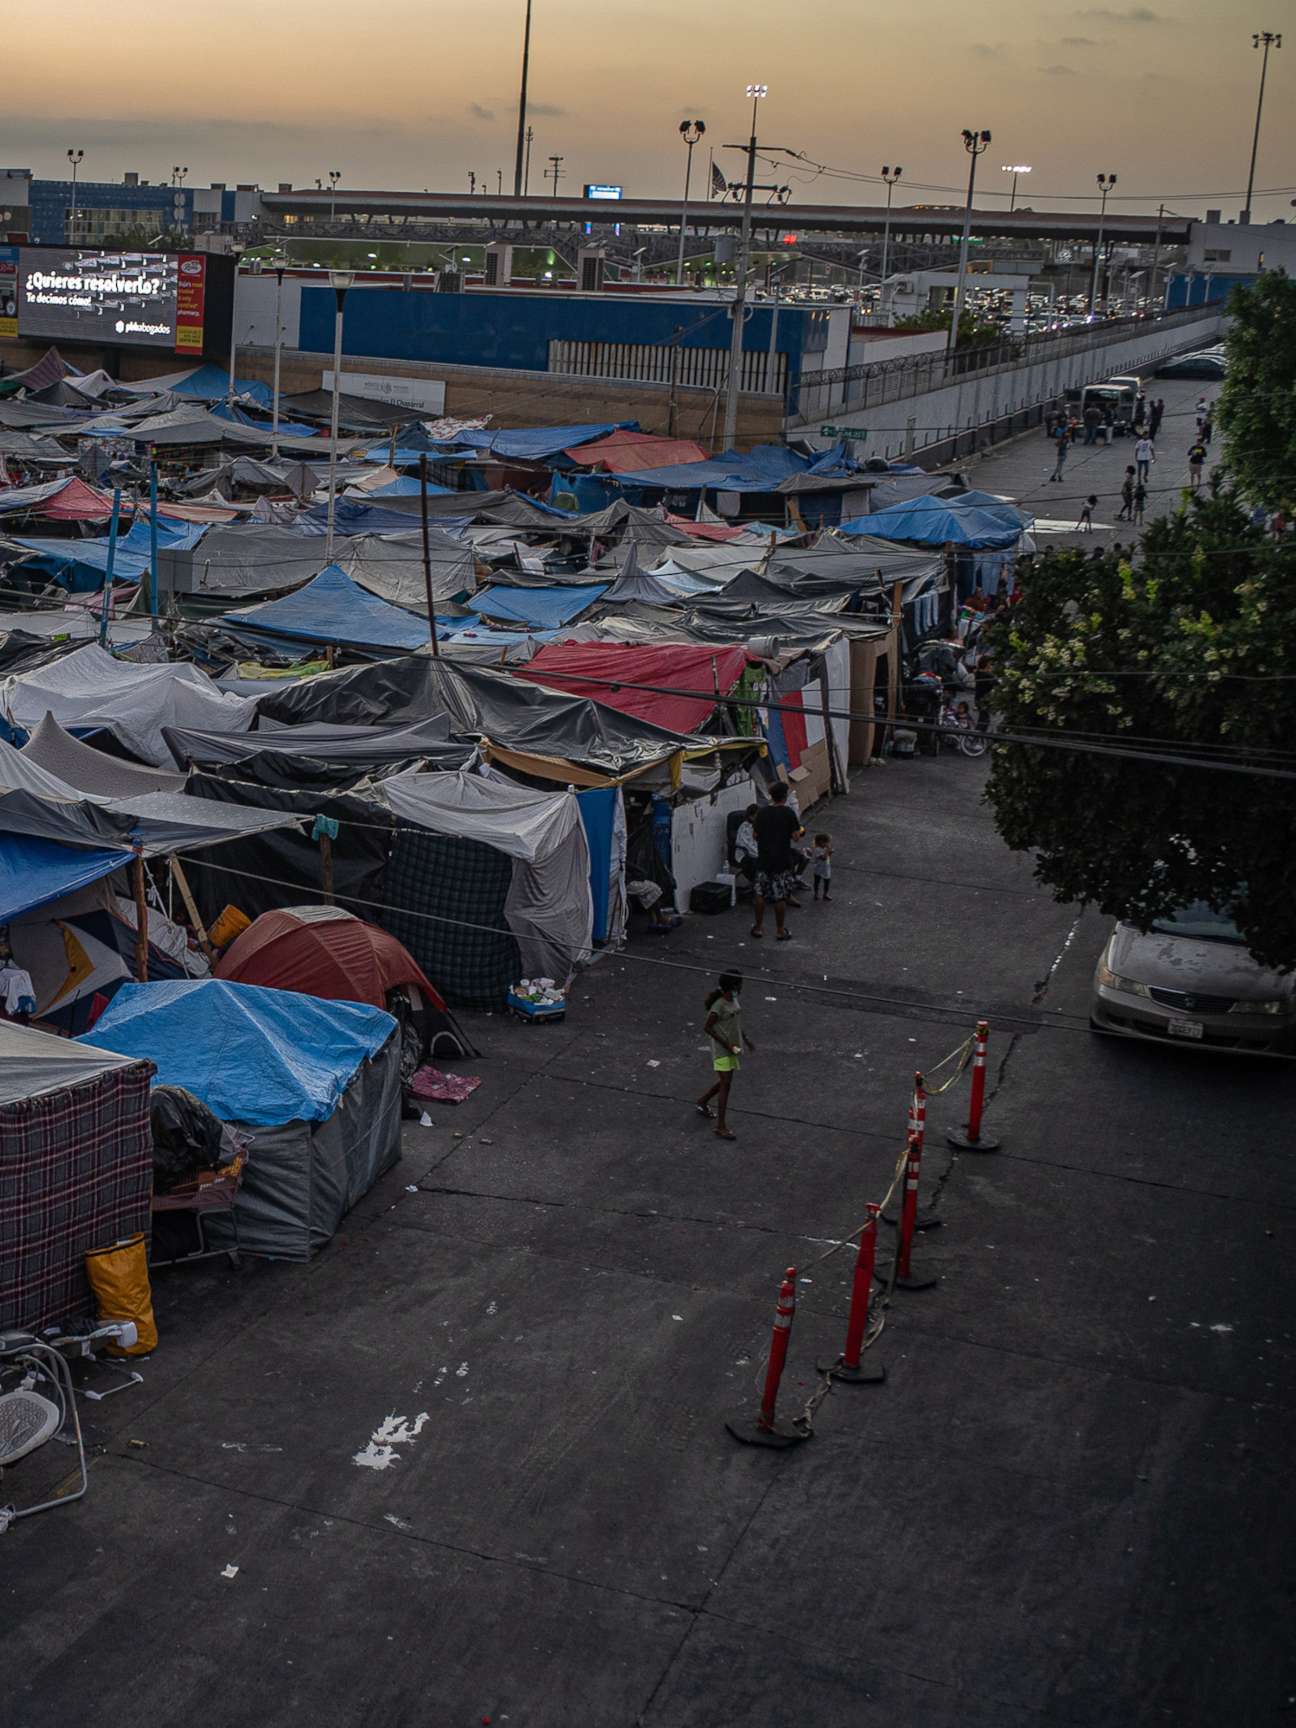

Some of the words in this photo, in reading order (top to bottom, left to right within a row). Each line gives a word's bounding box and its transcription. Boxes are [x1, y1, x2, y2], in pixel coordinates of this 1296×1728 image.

[26, 271, 82, 291] ¿Quieres
[84, 273, 160, 295] resolverlo?
[26, 292, 36, 303] Te
[36, 293, 67, 305] decimos
